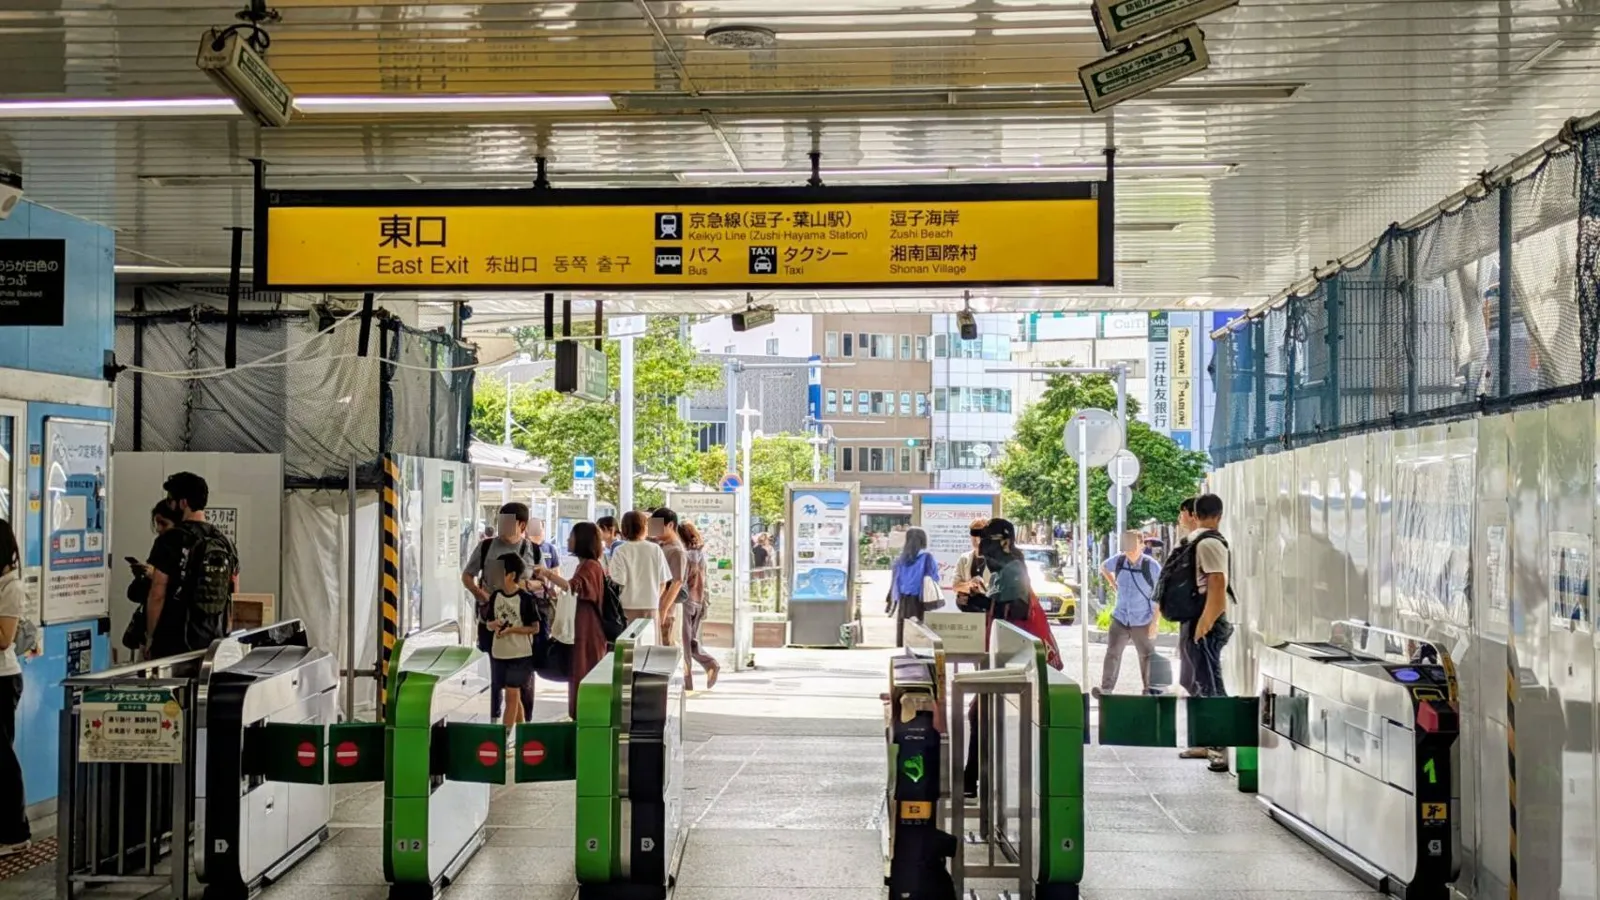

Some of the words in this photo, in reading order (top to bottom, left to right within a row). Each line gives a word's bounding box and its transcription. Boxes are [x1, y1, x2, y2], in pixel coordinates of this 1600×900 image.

[689, 210, 852, 229] 京急線（逗子・葉山駅）
[890, 209, 960, 227] 逗子海岸
[379, 214, 446, 248] 東口
[725, 231, 747, 241] Line
[829, 229, 868, 240] Station)
[890, 229, 918, 240] Zushi
[920, 228, 953, 239] Beach
[689, 247, 722, 263] バス
[751, 247, 775, 255] TAXI
[784, 246, 849, 262] タクシー
[890, 244, 978, 262] 湘南国際村
[378, 256, 423, 274] East
[430, 255, 469, 274] Exit
[486, 255, 538, 273] 东出口
[553, 255, 588, 273] 동쪽
[596, 255, 631, 273] 출구
[689, 265, 708, 275] Bus
[785, 265, 804, 275] Taxi
[890, 264, 929, 274] Shonan
[932, 264, 967, 276] Village
[1154, 347, 1167, 428] 三井住友銀行
[218, 842, 223, 850] 1
[400, 841, 405, 850] 1
[413, 841, 420, 850] 2
[589, 840, 596, 849] 2
[643, 840, 650, 849] 3
[1432, 841, 1440, 850] 5
